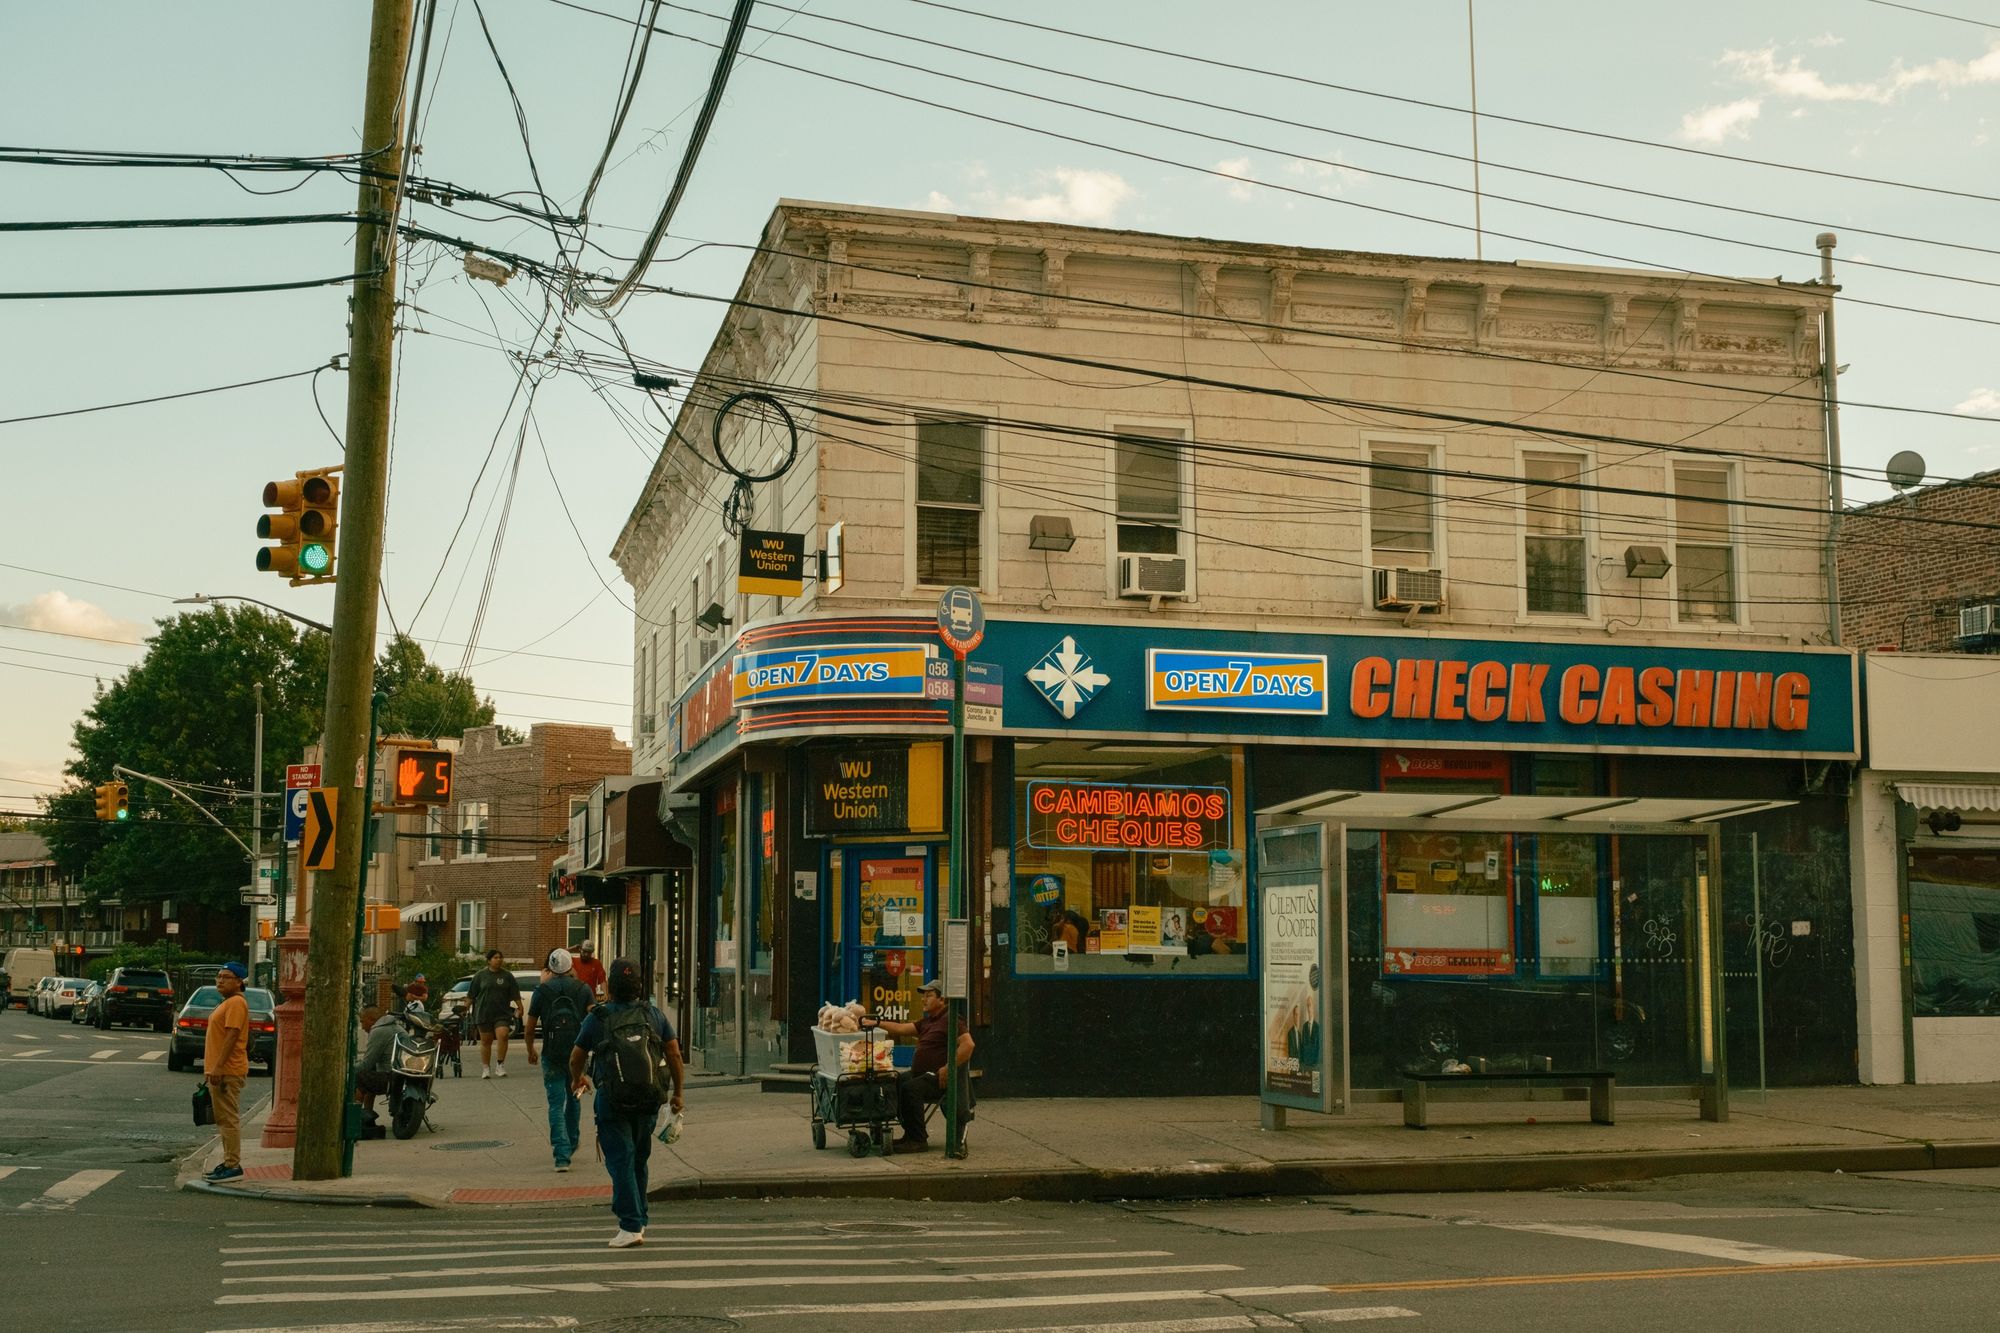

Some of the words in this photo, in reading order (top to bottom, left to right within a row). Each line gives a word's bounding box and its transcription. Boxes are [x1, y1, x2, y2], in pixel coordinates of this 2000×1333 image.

[762, 539, 784, 550] WU
[750, 549, 795, 563] Western
[757, 560, 788, 572] Union
[942, 628, 952, 641] NO
[951, 631, 981, 651] STANDING
[747, 665, 796, 689] OPEN
[795, 654, 820, 684] 7
[818, 662, 890, 682] DAYS
[928, 661, 949, 677] Q58
[967, 665, 988, 676] Flushing
[1164, 670, 1228, 695] OPEN
[1227, 661, 1253, 694] 7
[1251, 674, 1314, 697] DAYS
[928, 681, 949, 697] Q58
[1350, 656, 1549, 724] CHECK
[1559, 665, 1810, 731] CASHING
[966, 706, 983, 714] Corona
[966, 713, 987, 722] Junction
[840, 761, 872, 779] WU
[1411, 758, 1442, 770] BOSS
[1444, 759, 1493, 770] REVOLUTION
[435, 761, 449, 795] 5
[823, 782, 888, 801] Western
[834, 802, 878, 819] Union
[1033, 786, 1225, 820] CAMBIAMOS
[1056, 818, 1204, 847] CHEQUES
[1277, 915, 1317, 938] COOPER
[1415, 955, 1447, 967] BOSS
[1447, 956, 1497, 967] REVOLUTION
[874, 986, 911, 1006] Open
[875, 1005, 910, 1020] 24Hr
